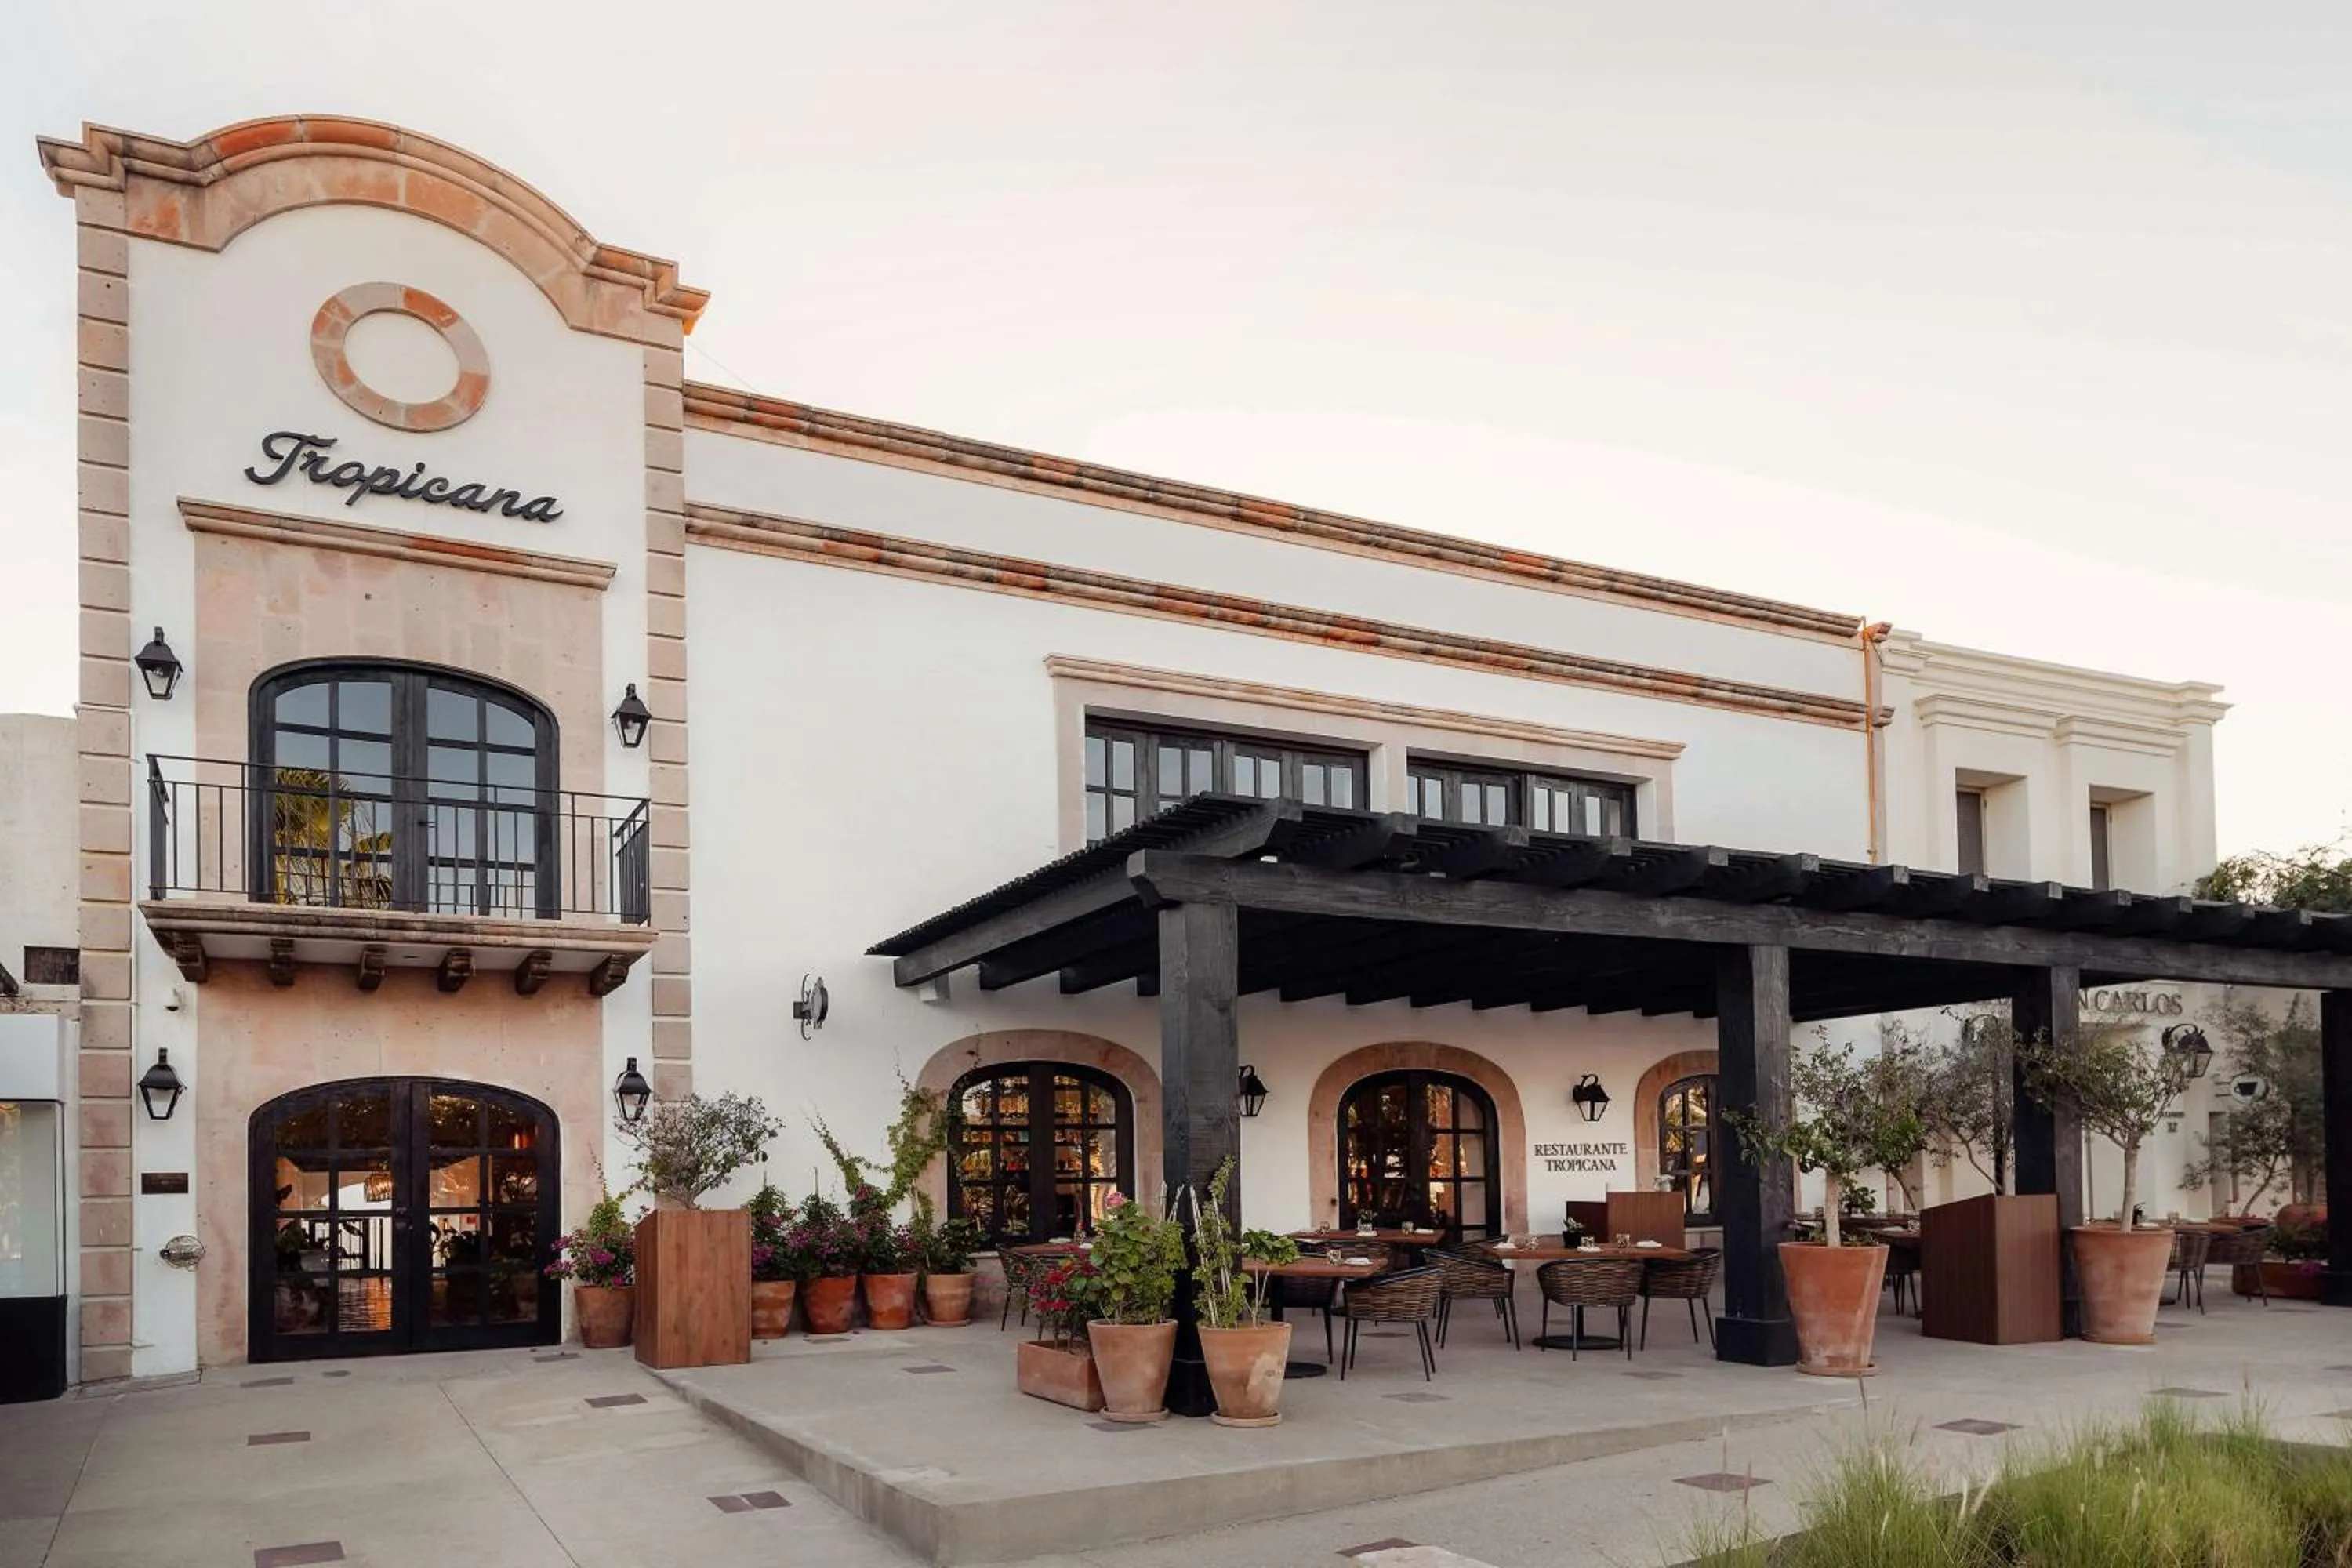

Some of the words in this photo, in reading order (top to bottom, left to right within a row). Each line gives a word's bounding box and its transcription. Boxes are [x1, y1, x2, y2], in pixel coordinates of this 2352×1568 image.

[245, 431, 564, 523] Tropicana
[2094, 989, 2183, 1015] CARLOS
[1534, 1142, 1628, 1156] RESTAURANTE
[1544, 1158, 1617, 1172] TROPICANA
